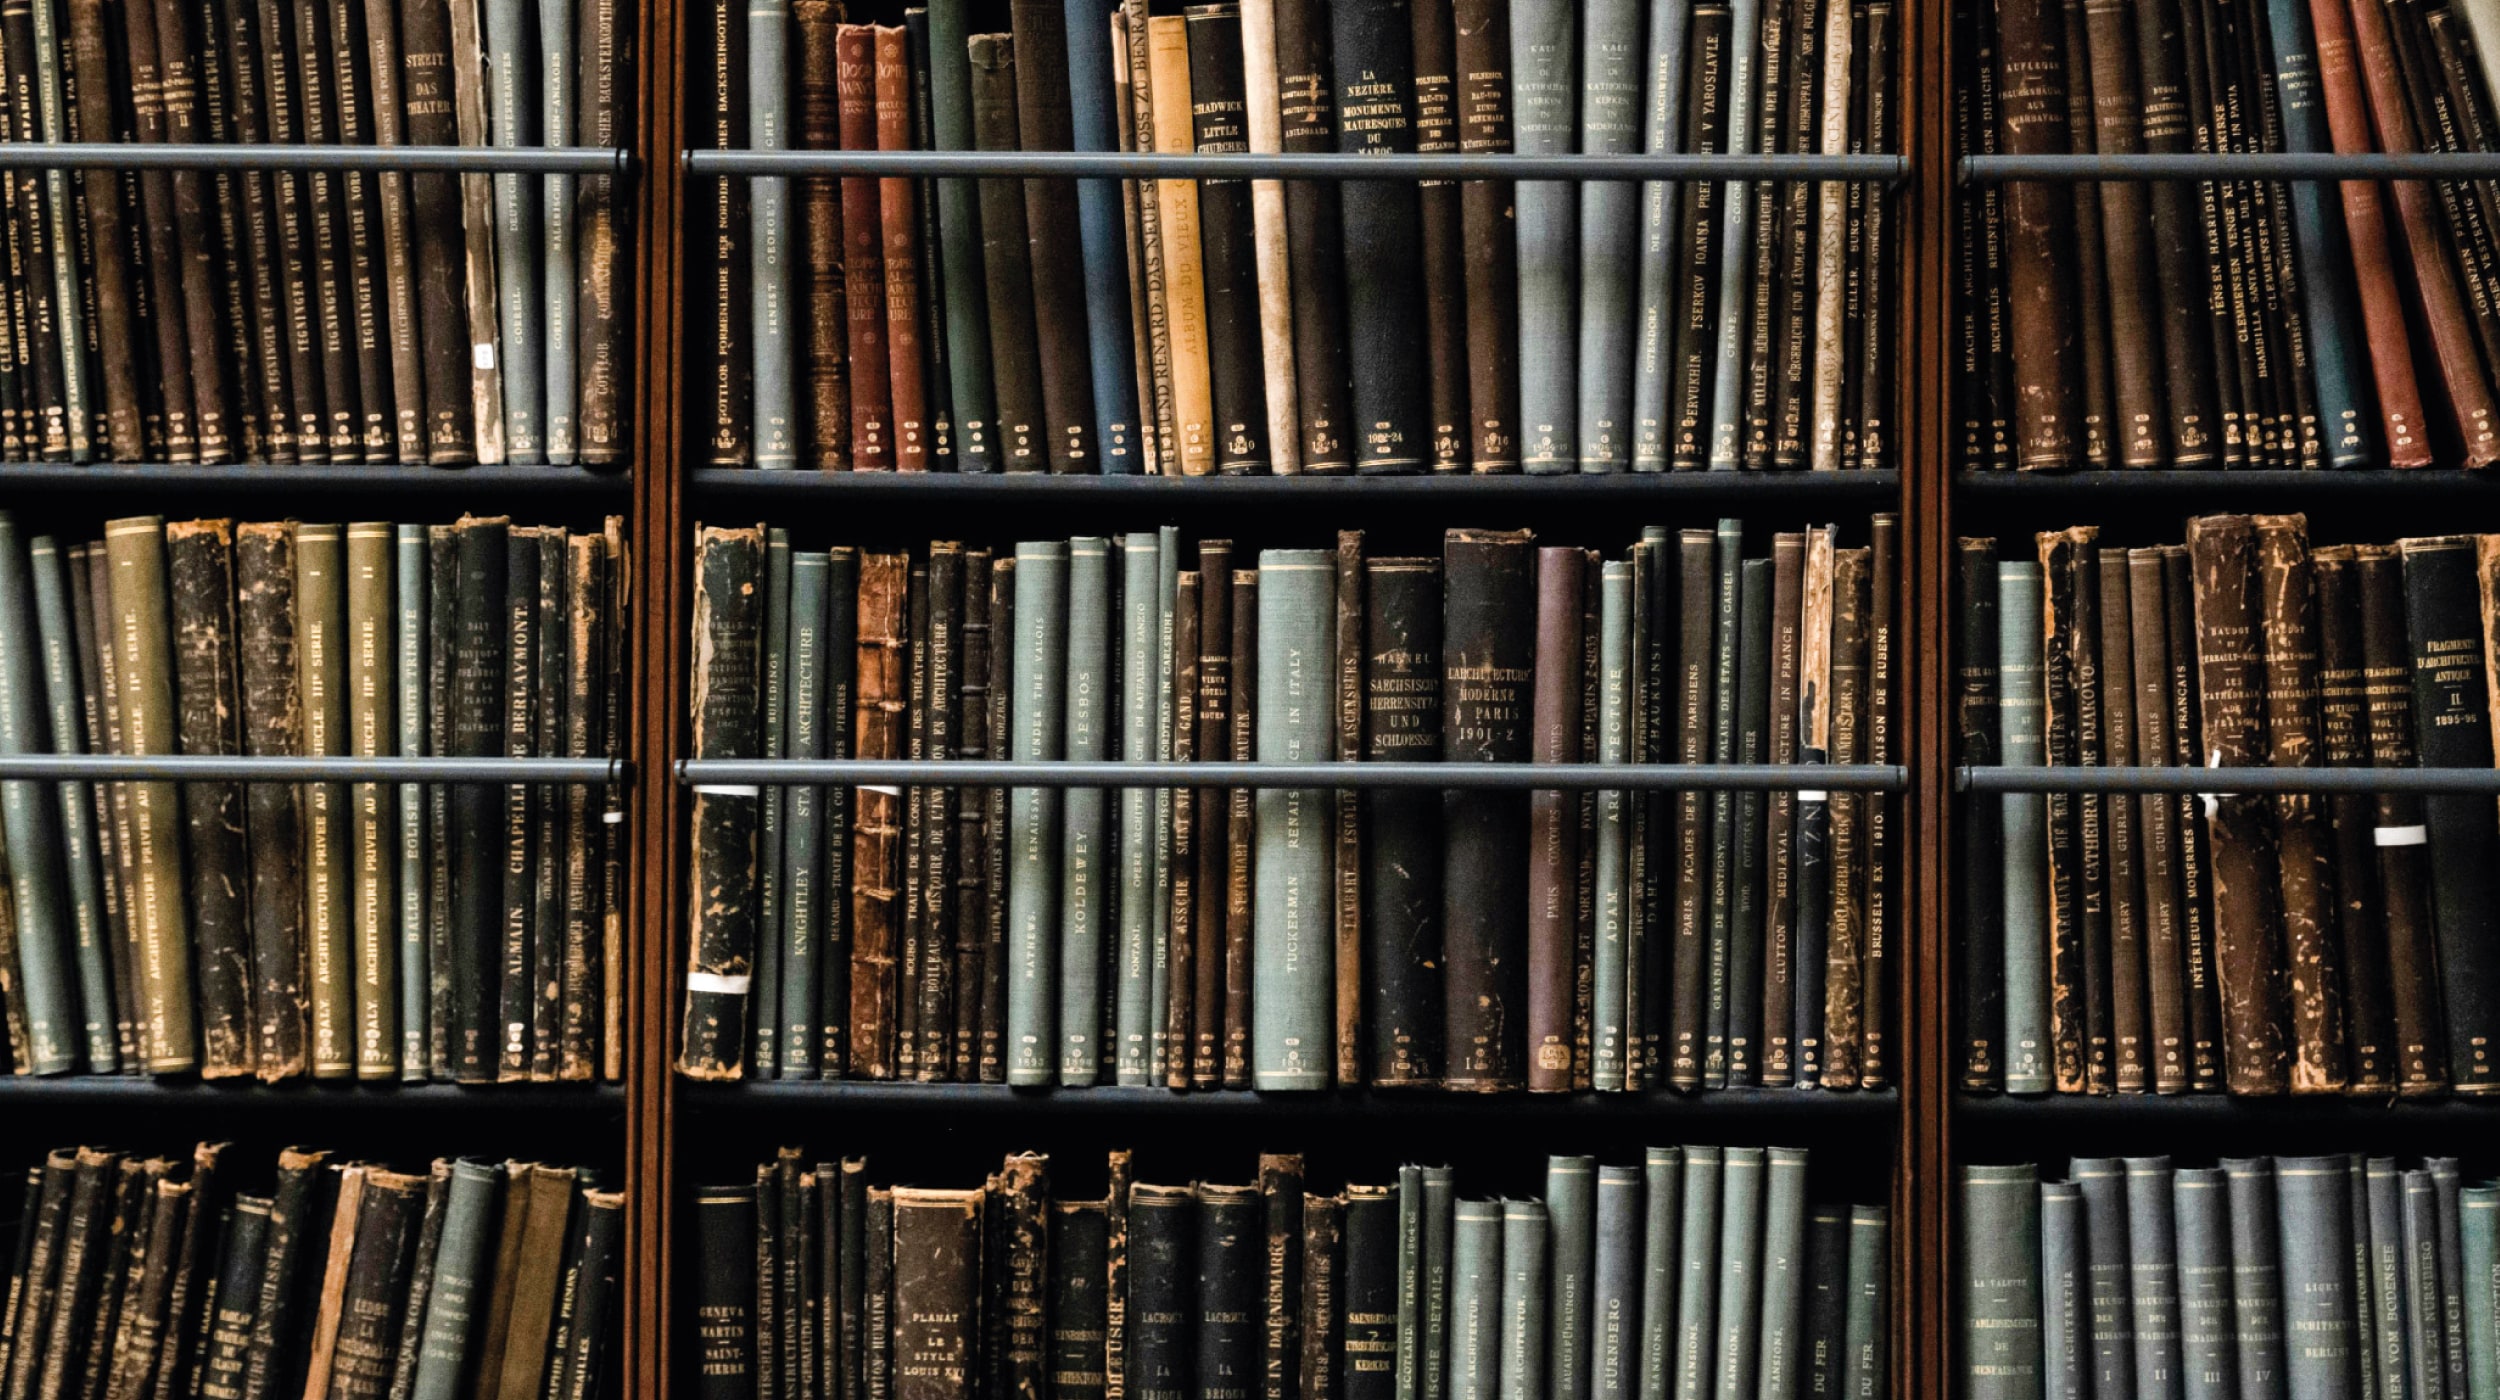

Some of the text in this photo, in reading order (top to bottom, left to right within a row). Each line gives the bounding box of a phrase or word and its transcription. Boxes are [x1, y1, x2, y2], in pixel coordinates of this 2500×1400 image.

[1361, 70, 1376, 81] LA
[1736, 56, 1748, 149] ARCHITECTURE
[1204, 125, 1239, 139] LITTLE
[1343, 103, 1402, 117] MONUMENTS
[1343, 117, 1407, 131] MAURESQUES
[1367, 133, 1382, 144] DU
[270, 51, 310, 352] TEGNINGER AF ARCHITEKTUR
[305, 51, 342, 352] TEGNINGER AF ARCHITEKTUR
[339, 50, 376, 350] TEGNINGER AF ARCHITEKTUR
[1645, 305, 1657, 373] OSTENDORF.
[1657, 54, 1669, 121] DACHWERKS
[1690, 34, 1720, 329] TSERKOV IOANNA YAROSLAVLE.
[718, 235, 730, 258] DER
[1134, 79, 1168, 379] RENARD DAS NEUE ZU
[1178, 264, 1192, 286] DU
[1848, 267, 1860, 318] ZELLER.
[261, 307, 275, 319] AF
[718, 267, 729, 354] FORMENLEHRE
[766, 283, 777, 334] ERNEST
[1181, 297, 1197, 354] ALBUM
[262, 325, 281, 392] TEGNINGER
[1876, 624, 1888, 678] RUBENS.
[1390, 714, 1421, 728] UND
[1476, 706, 1520, 721] PARIS
[1876, 688, 1886, 704] DE
[2112, 710, 2125, 749] PARIS
[2148, 711, 2162, 750] PARIS
[406, 685, 419, 942] BALLU. EGLISE SAINTE
[508, 605, 528, 976] ALMAIN. BERLAYMONT.
[794, 628, 813, 956] KNIGHTLEY ARCHITECTURE
[907, 709, 922, 920] TRAITÉ DE LA DES
[1026, 617, 1044, 977] MATHEWS. UNDER THE VALOIS
[1074, 672, 1089, 934] KOLDEWEY LESBOS
[1286, 647, 1302, 974] TUCKERMAN IN ITALY
[1685, 805, 1695, 821] DE
[1714, 914, 1724, 928] DE
[1720, 689, 1729, 711] DES
[1776, 626, 1792, 983] CLUTTON MEDIÆVAL IN FRANCE
[143, 873, 161, 979] ARCHITECTURE
[318, 873, 330, 985] ARCHITECTURE
[366, 878, 377, 984] ARCHITECTURE
[1606, 888, 1618, 942] ADAM.
[1682, 896, 1693, 936] PARIS.
[1872, 892, 1884, 958] BRUSSELS
[2086, 892, 2101, 913] LA
[1404, 1325, 1413, 1389] SCOTLAND.
[1605, 1298, 1620, 1389] NÜRNBERG
[1815, 1372, 1825, 1392] DU
[1861, 1377, 1873, 1397] DU
